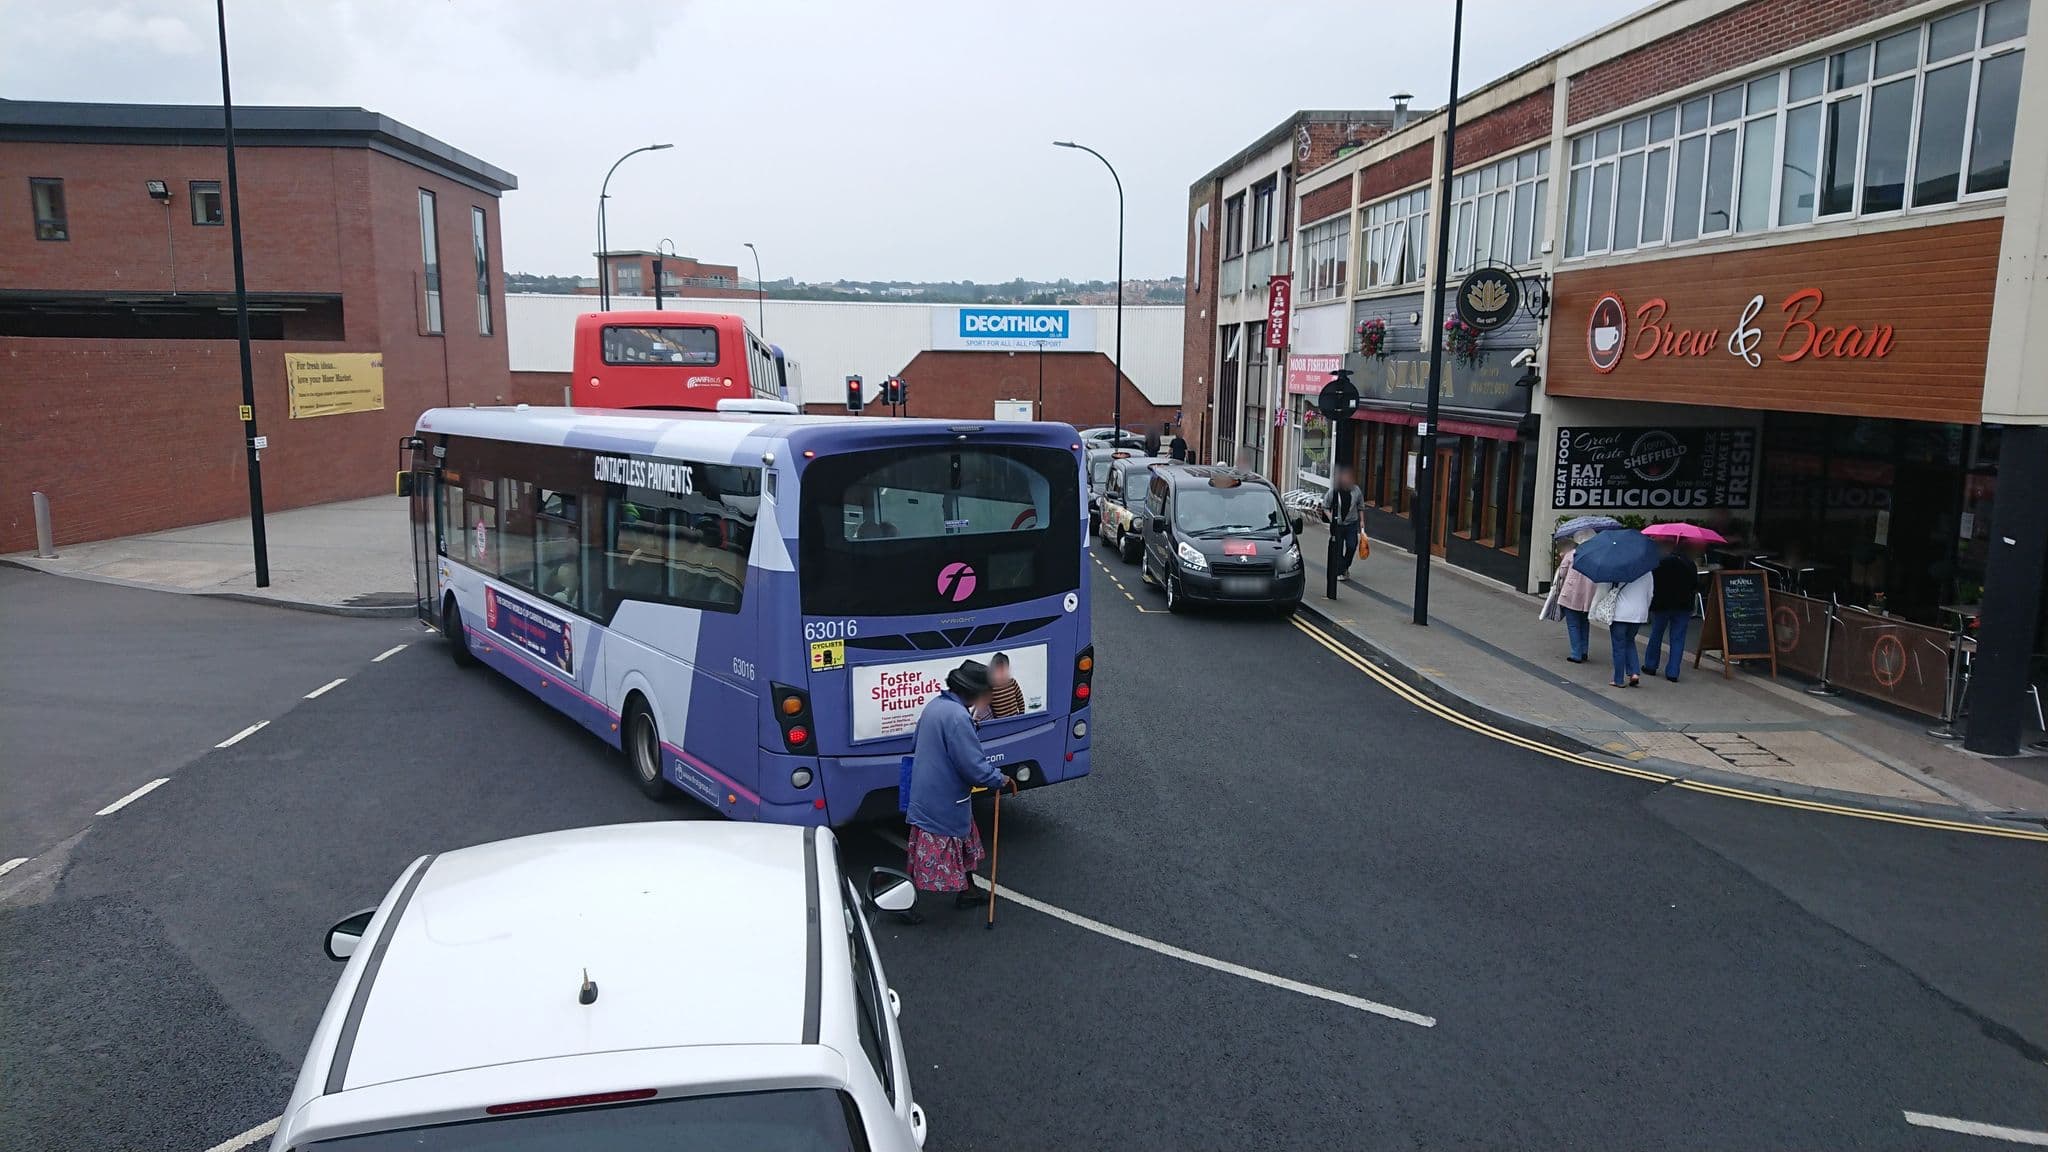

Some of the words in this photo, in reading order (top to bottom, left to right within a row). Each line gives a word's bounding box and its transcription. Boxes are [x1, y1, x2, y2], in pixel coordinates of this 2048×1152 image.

[1274, 285, 1284, 307] FISH
[965, 315, 1063, 332] DECATHLON
[1272, 318, 1283, 344] CHIPS
[1632, 297, 1721, 361] Brew
[1727, 294, 1765, 368] &
[1776, 287, 1897, 362] Bean
[296, 361, 305, 370] For
[306, 361, 320, 370] fresh
[1290, 358, 1306, 371] MOOR
[1307, 359, 1340, 372] FISHERIES
[297, 376, 308, 384] love
[309, 376, 321, 386] your
[1386, 360, 1455, 397] SHAPA
[1559, 429, 1571, 464] FOOD
[1573, 432, 1622, 451] Great
[1624, 445, 1688, 469] SHEFFIELD
[1717, 445, 1729, 480] MAKE
[594, 455, 645, 488] CONTACTLESS
[647, 462, 693, 495] PAYMENTS
[1571, 464, 1604, 478] EAT
[1728, 431, 1752, 506] FRESH
[1555, 468, 1568, 506] GREAT
[1571, 478, 1603, 487] FRESH
[1569, 488, 1708, 507] DELICIOUS
[1715, 485, 1725, 505] WE
[1183, 561, 1202, 571] TAXI
[805, 619, 857, 640] 63016
[941, 616, 976, 625] WRIGHT
[812, 641, 842, 649] CYCLISTS
[732, 657, 755, 681] 63016
[881, 671, 922, 686] Foster
[871, 679, 941, 700] Sheffield's
[881, 695, 925, 712] Future
